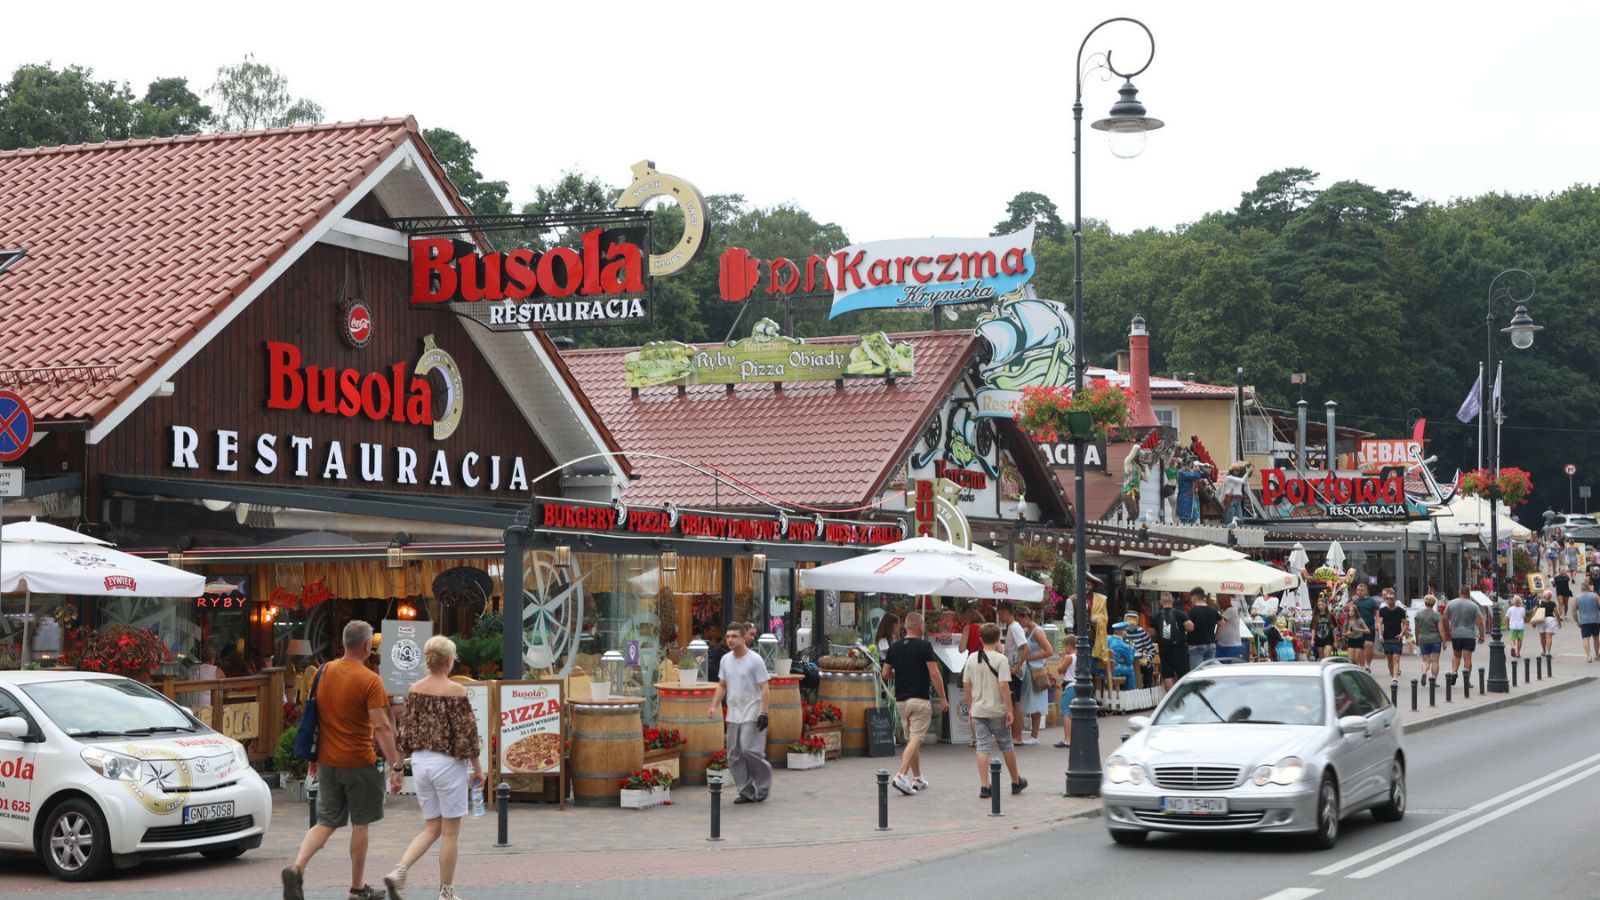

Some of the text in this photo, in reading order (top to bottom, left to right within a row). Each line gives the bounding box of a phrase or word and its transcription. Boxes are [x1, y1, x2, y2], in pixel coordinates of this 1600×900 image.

[409, 228, 645, 304] Busola
[832, 248, 1026, 291] Karczma
[896, 280, 996, 310] Krynicka
[490, 298, 645, 325] RESTAURACJA
[696, 351, 736, 371] Ryby
[738, 360, 785, 380] Pizza
[788, 350, 844, 368] Obiady
[266, 340, 434, 427] Busola
[171, 425, 530, 490] RESTAURACJA
[1261, 467, 1405, 506] Portowa
[543, 503, 617, 531] BURGERY
[628, 510, 671, 534] PIZZA
[680, 514, 781, 541] OBIADY DOMOWE
[788, 522, 816, 542] RYBY
[196, 597, 247, 608] RYBY
[512, 690, 541, 698] Busola
[499, 698, 561, 727] PIZZA
[0, 757, 34, 780] ola
[12, 800, 31, 813] 625
[190, 807, 208, 820] GND
